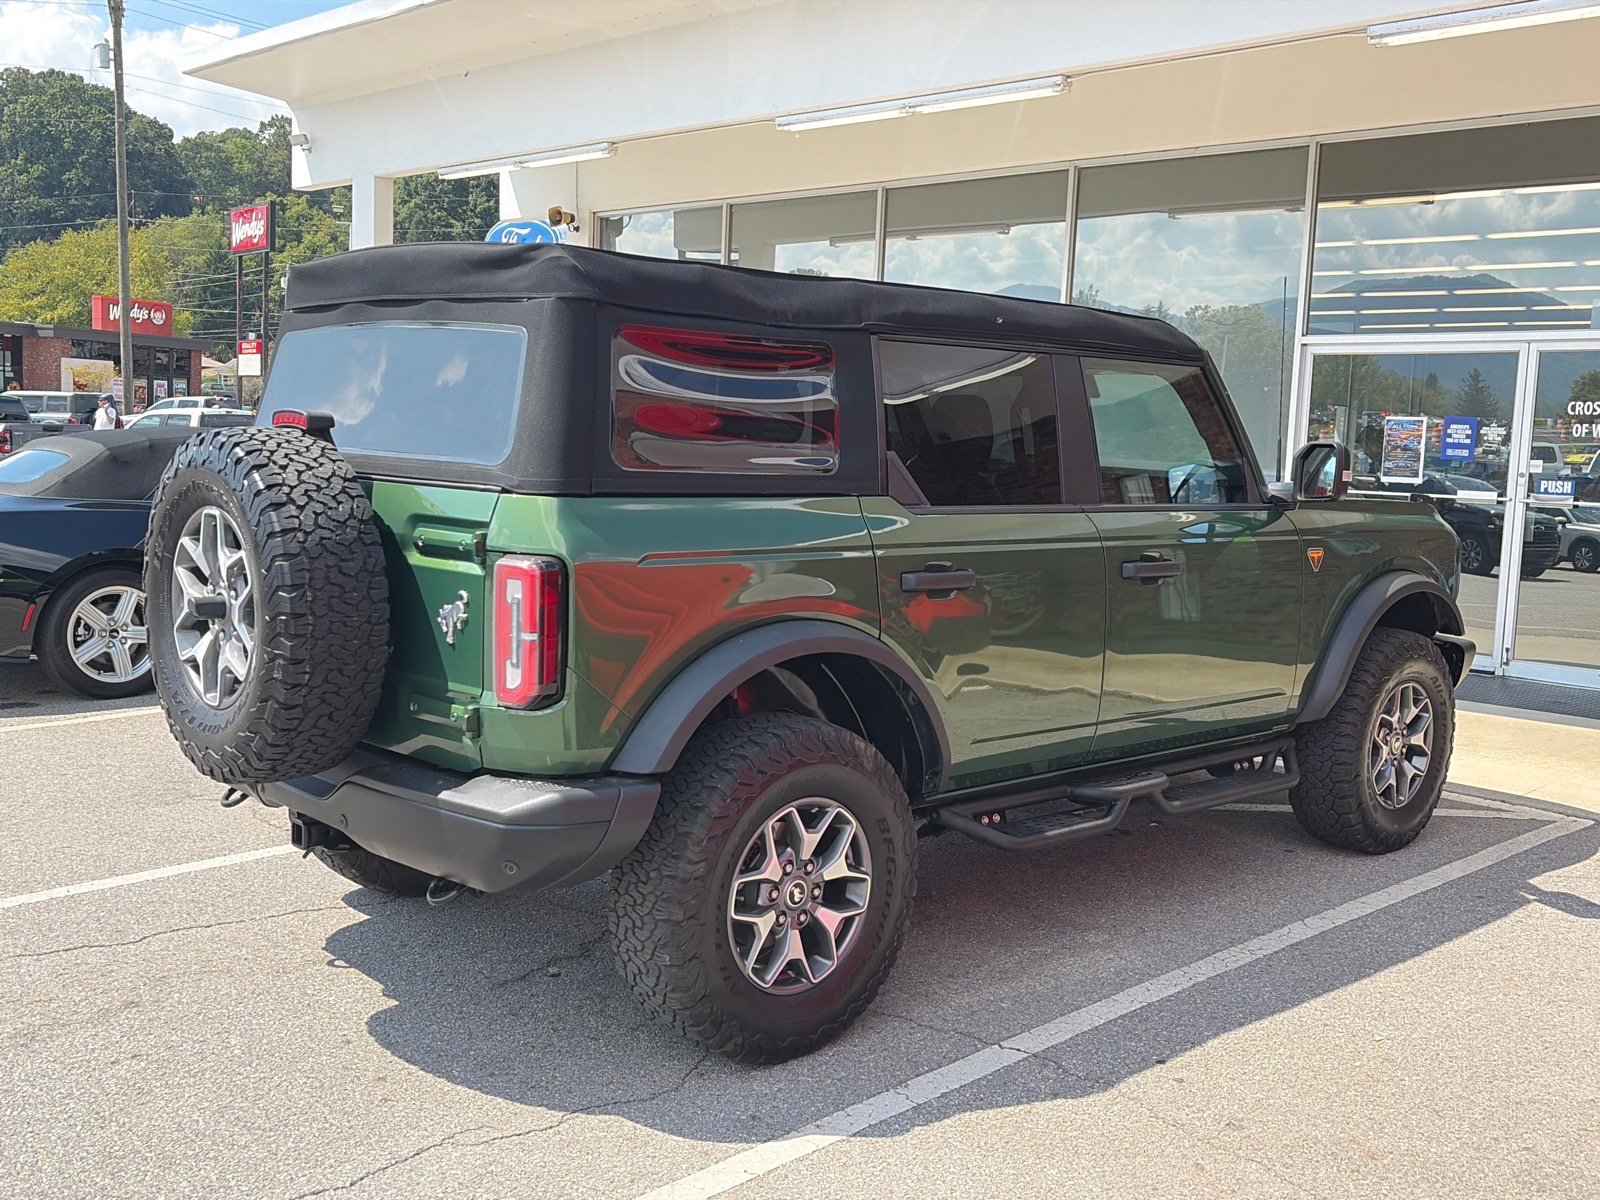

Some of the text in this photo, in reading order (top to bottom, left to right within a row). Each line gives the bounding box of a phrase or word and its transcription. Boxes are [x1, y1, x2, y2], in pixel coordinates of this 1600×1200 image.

[232, 212, 265, 247] Wendy's
[109, 303, 149, 323] Wdy's
[1567, 401, 1600, 416] CROS
[1572, 423, 1589, 438] OF
[1540, 480, 1572, 494] PUSH
